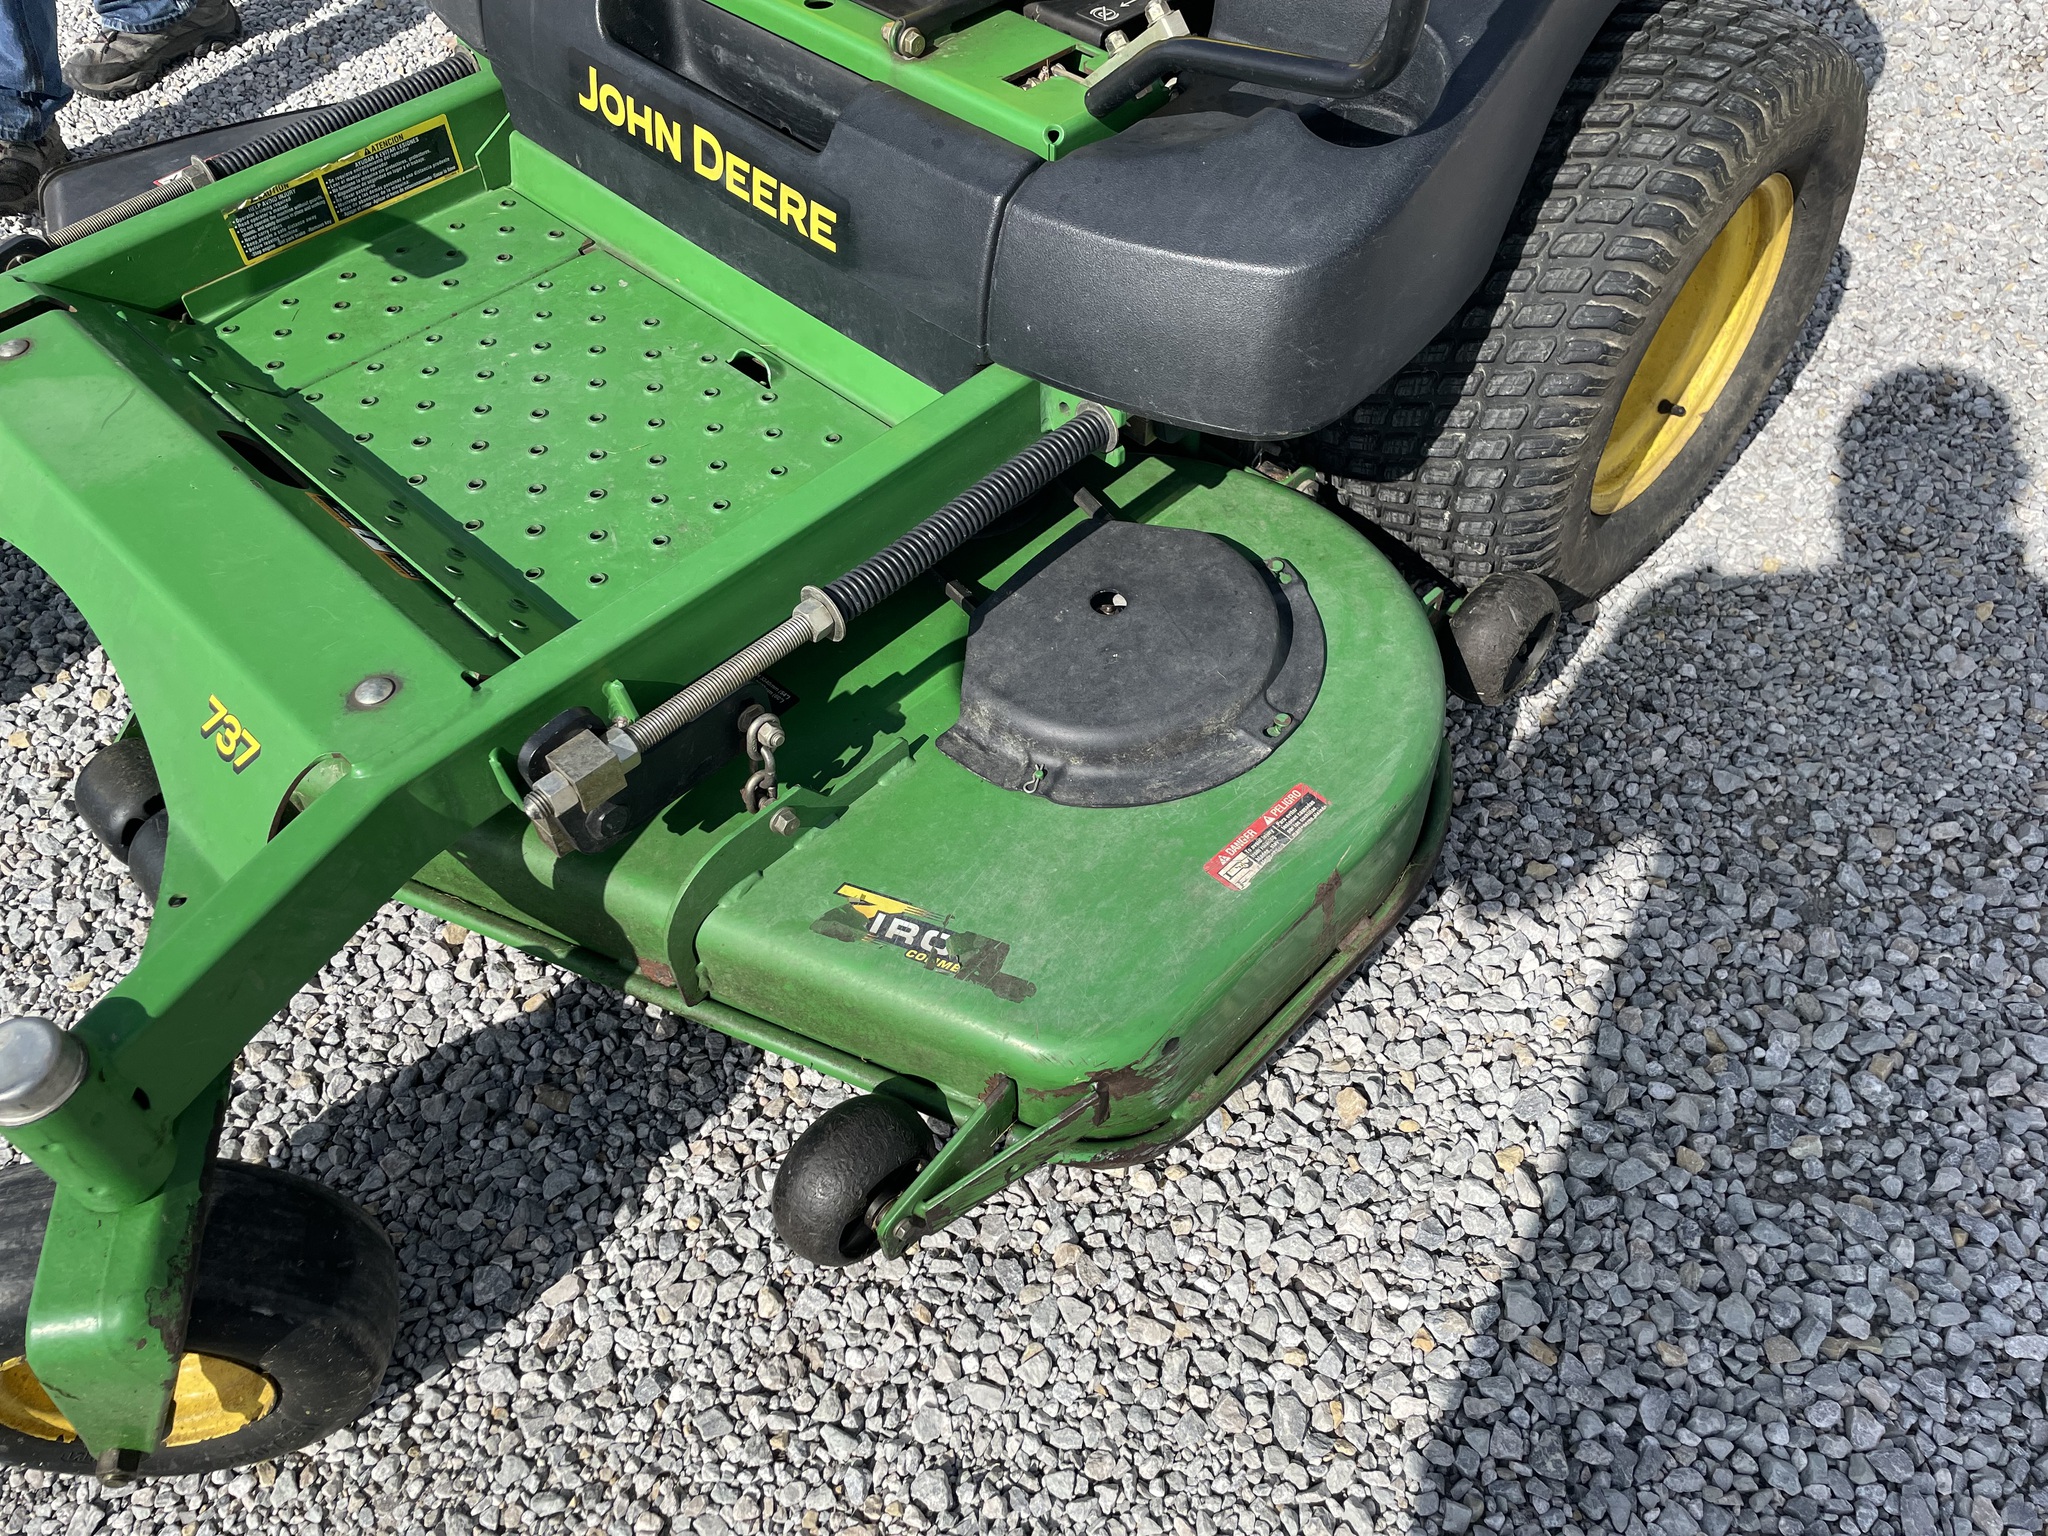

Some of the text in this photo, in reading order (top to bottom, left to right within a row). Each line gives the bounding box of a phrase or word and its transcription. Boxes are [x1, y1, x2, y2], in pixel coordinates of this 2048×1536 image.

[370, 134, 404, 151] ATENCION
[578, 65, 837, 253] JOHN DEERE
[247, 203, 261, 212] HELP
[277, 188, 296, 199] INJURY
[258, 183, 289, 200] AUTION
[200, 693, 262, 775] 737
[1225, 828, 1256, 855] DANGER
[1270, 789, 1301, 816] PELIGRO
